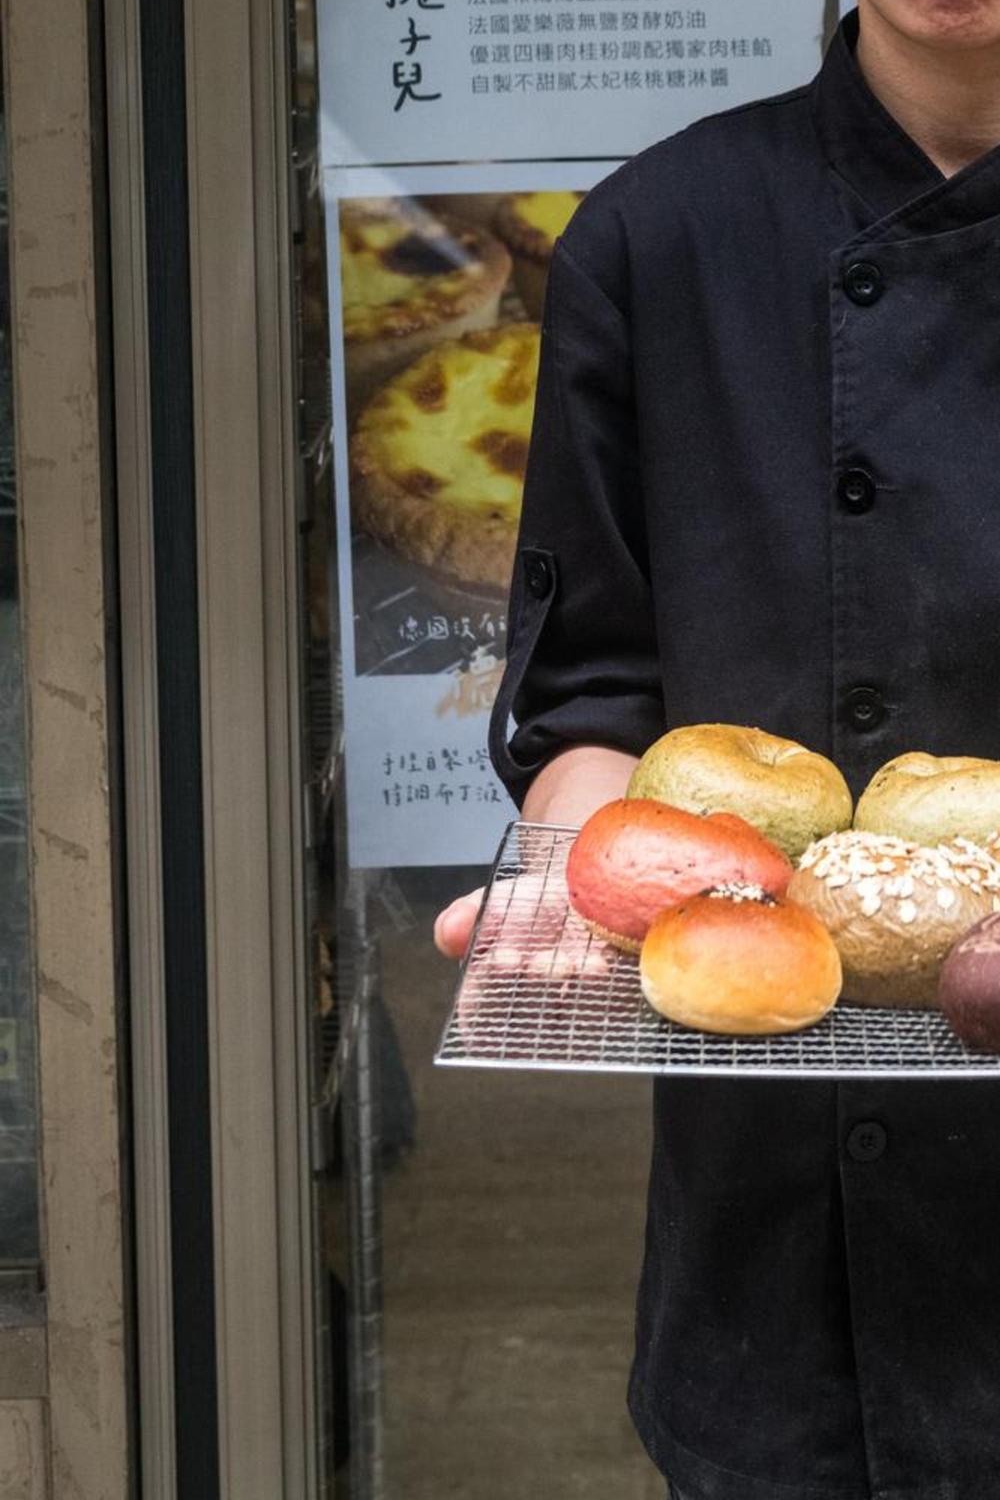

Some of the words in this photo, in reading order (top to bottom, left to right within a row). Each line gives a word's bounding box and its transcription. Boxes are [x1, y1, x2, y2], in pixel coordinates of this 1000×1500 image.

[468, 10, 707, 36] 法國愛樂薇無鹽發酵奶油
[470, 37, 773, 65] 優選四種肉桂粉調配獨家肉桂餡
[471, 67, 730, 95] 自製不甜膩太妃核桃糖淋醬
